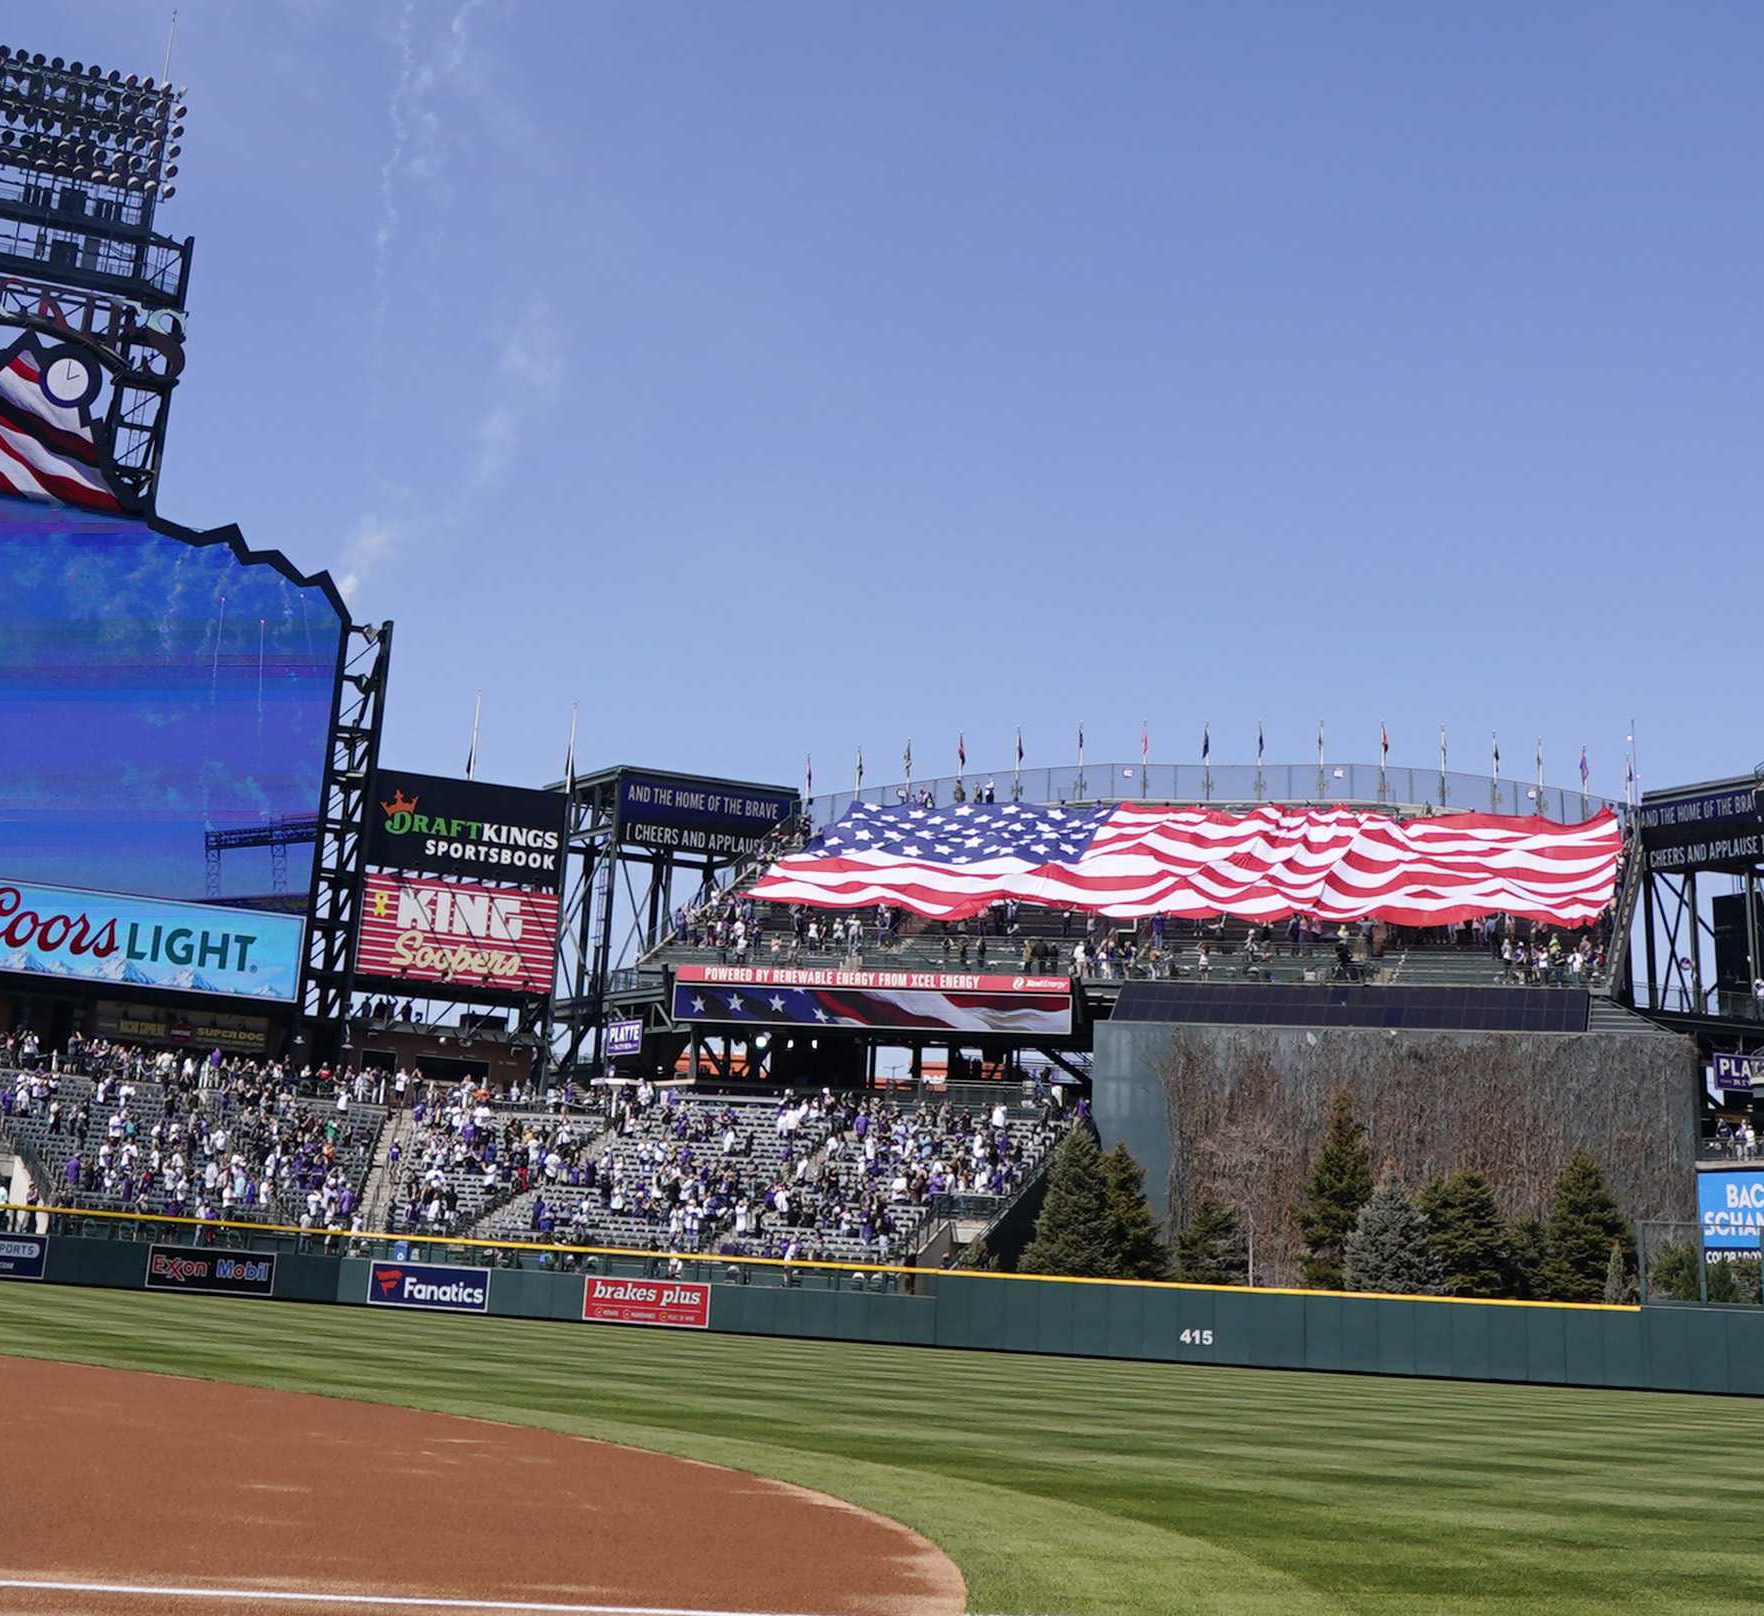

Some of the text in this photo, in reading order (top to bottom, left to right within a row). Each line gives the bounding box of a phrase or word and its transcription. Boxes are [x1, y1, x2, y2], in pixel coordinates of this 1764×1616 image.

[628, 785, 779, 820] AND THE HOME OF THE BRAVE
[1641, 793, 1756, 827] AND THE HOME OF THE BRA
[385, 811, 558, 850] DRAFTKINGS
[634, 823, 679, 846] CHEERS
[681, 830, 706, 849] AND
[708, 833, 763, 855] APPLAUS
[425, 840, 555, 870] SPORTSBOOK
[1650, 846, 1685, 868] CHEERS
[1687, 842, 1707, 863] AND
[1709, 835, 1758, 861] APPLAUSE
[396, 884, 523, 941] KING
[125, 922, 257, 972] LIGHT
[389, 929, 522, 981] Soopers
[705, 967, 980, 989] POWERED BY RENEWABLE ENERGY FROM XCEL ENERGY
[610, 1024, 640, 1043] PLATTE
[1719, 1058, 1760, 1077] PLAT
[152, 1254, 269, 1282] Exxon Mobil
[403, 1277, 484, 1304] Fanatics
[593, 1281, 701, 1306] brakes plus
[1179, 1328, 1214, 1345] 415
